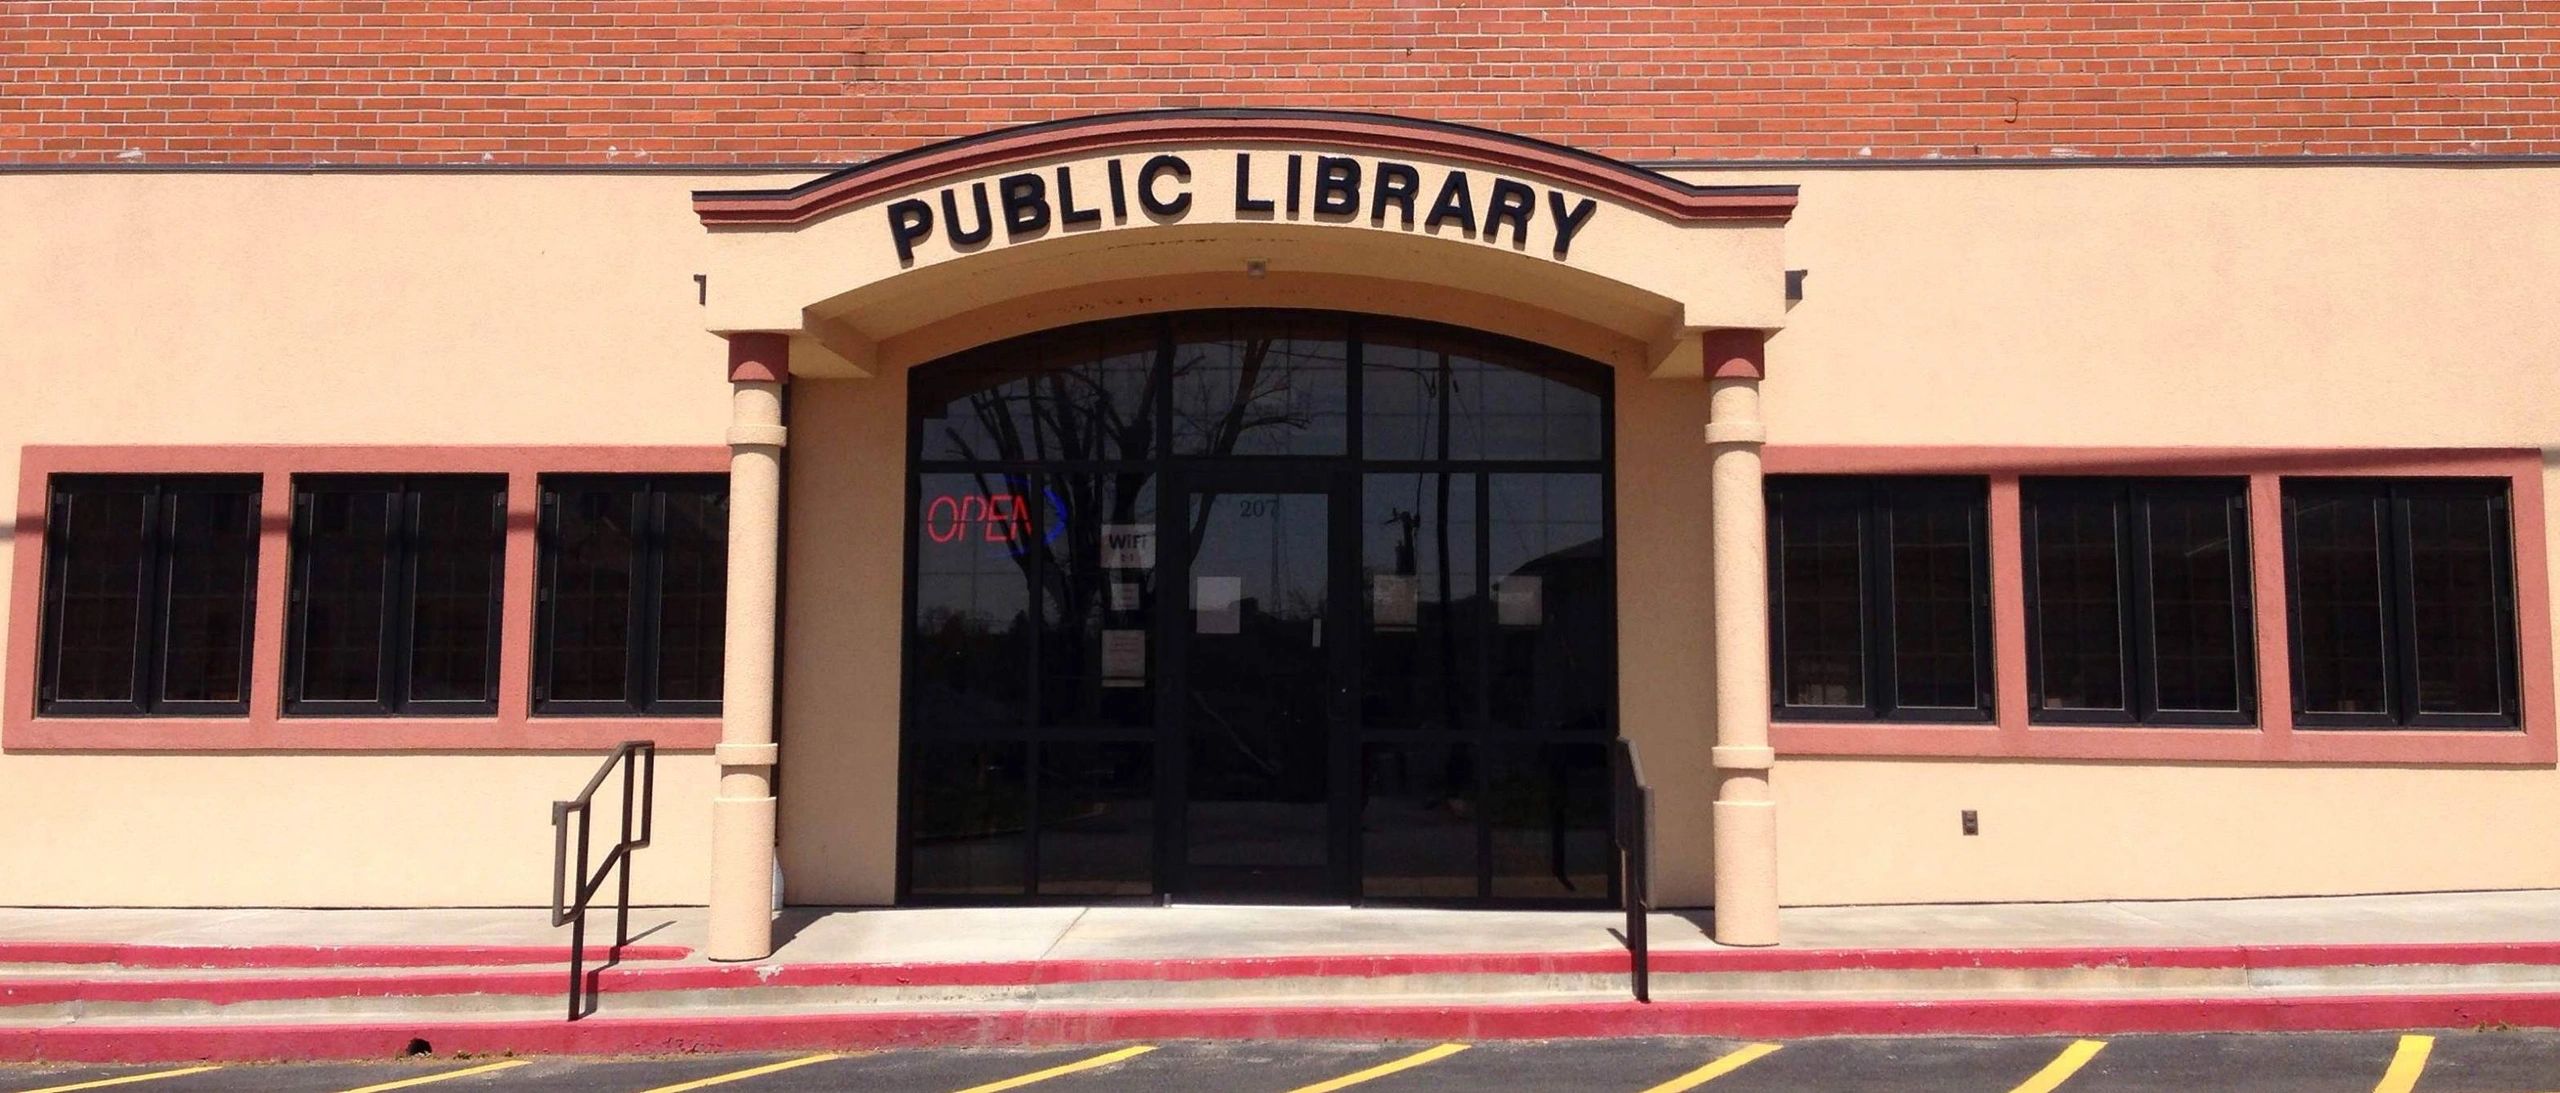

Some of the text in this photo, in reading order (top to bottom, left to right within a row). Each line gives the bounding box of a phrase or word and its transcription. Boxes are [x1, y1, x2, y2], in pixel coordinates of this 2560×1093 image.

[887, 152, 1598, 264] PUBLIC LIBRARY
[927, 495, 1034, 544] OPEN
[1240, 499, 1280, 519] 207
